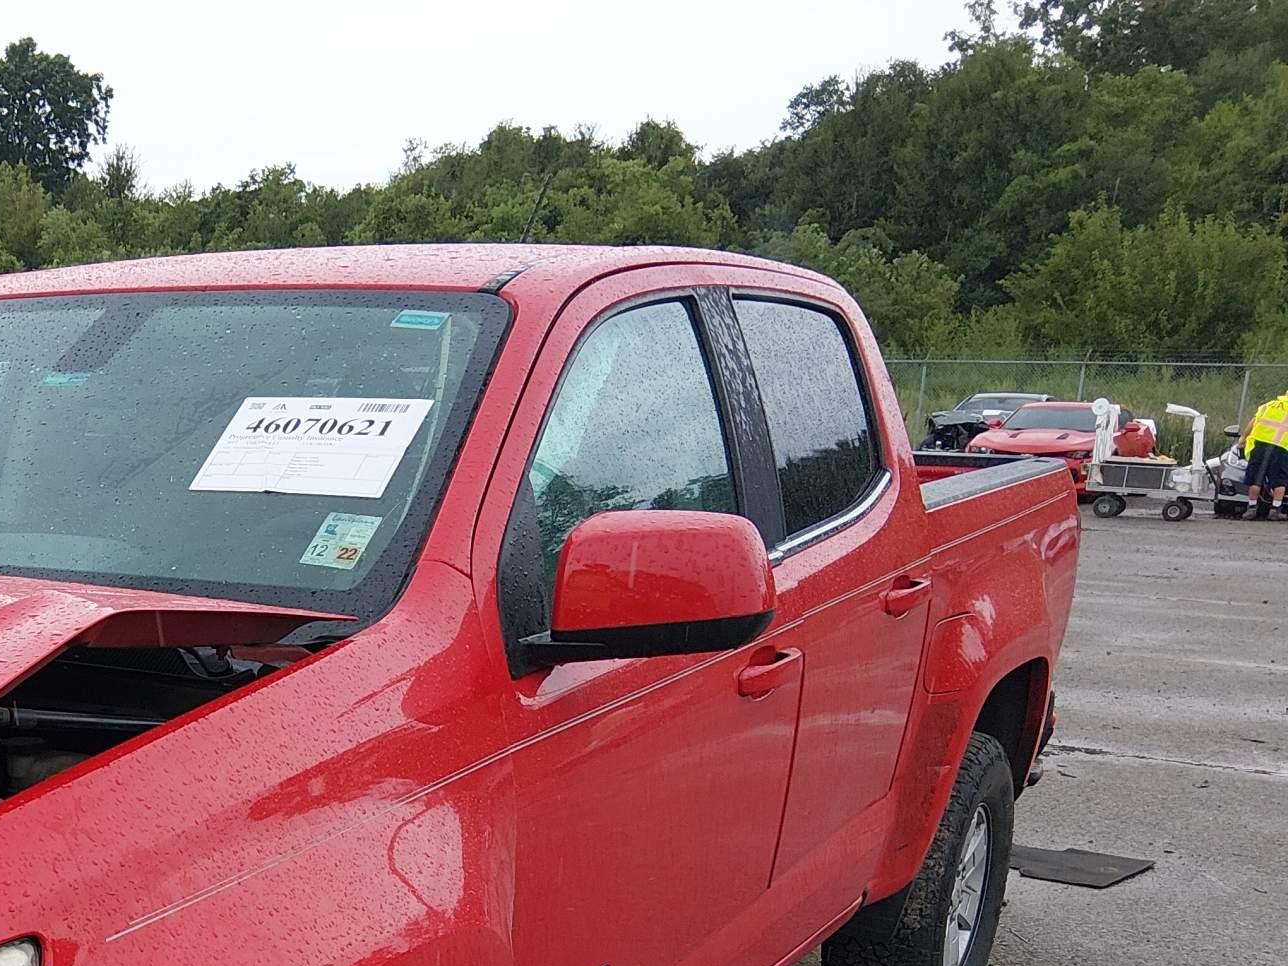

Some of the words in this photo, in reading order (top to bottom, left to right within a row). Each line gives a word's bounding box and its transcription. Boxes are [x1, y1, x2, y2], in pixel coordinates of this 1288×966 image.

[246, 416, 392, 436] 46070621
[310, 544, 329, 556] 12
[336, 547, 358, 560] 22
